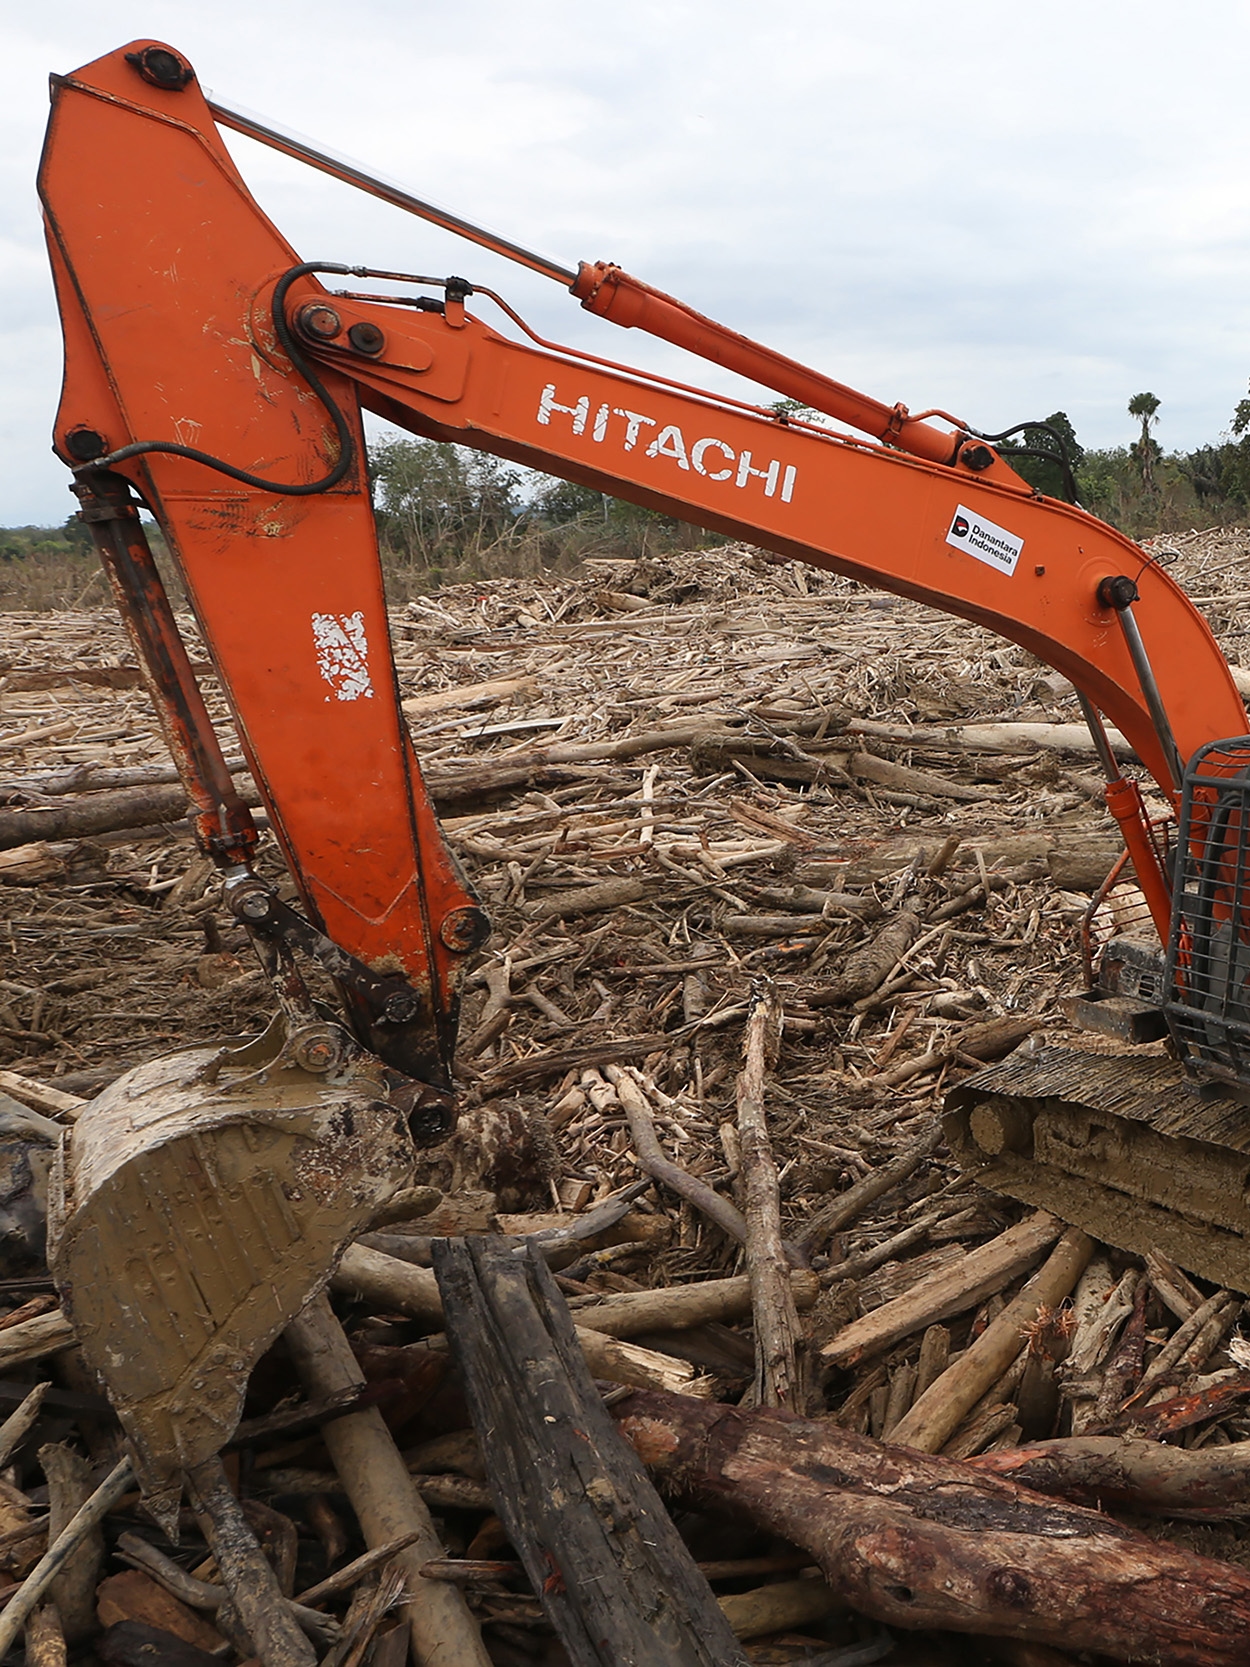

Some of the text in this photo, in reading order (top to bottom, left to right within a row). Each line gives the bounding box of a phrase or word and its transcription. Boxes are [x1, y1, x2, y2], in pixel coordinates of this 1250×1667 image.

[537, 384, 797, 503] HITACHI
[968, 534, 1013, 565] Indonesia
[972, 524, 1018, 557] Danantara
